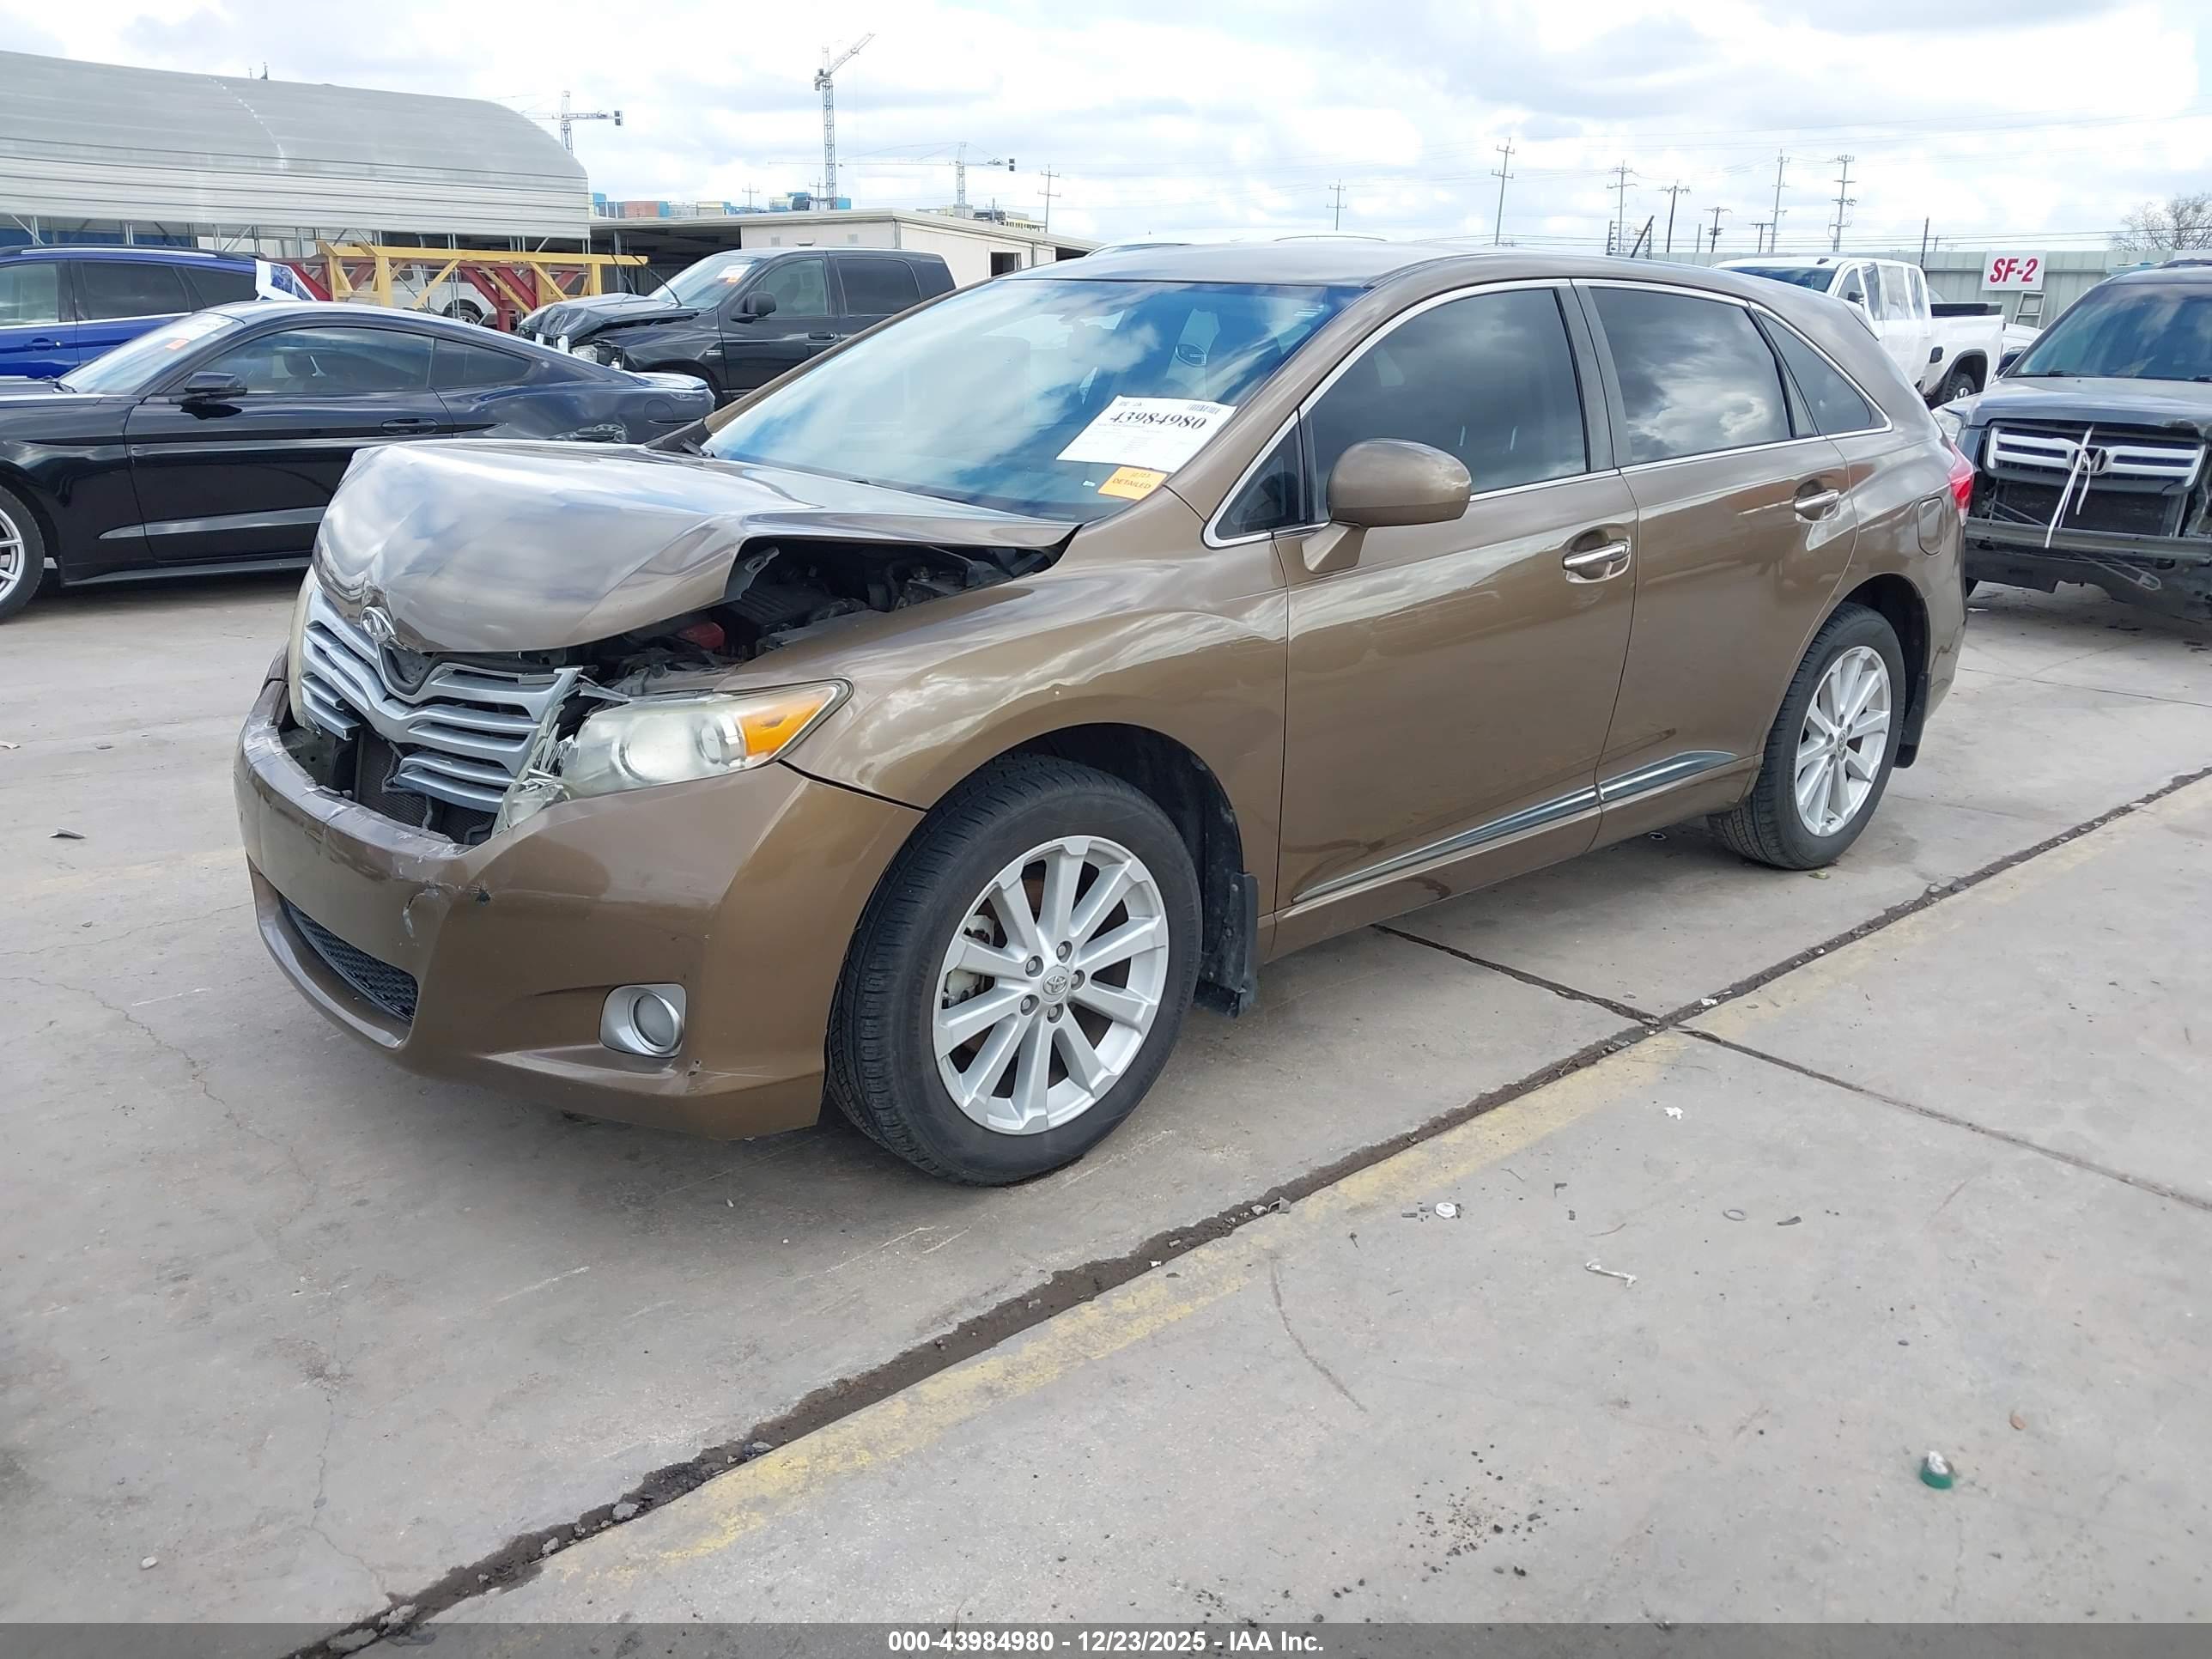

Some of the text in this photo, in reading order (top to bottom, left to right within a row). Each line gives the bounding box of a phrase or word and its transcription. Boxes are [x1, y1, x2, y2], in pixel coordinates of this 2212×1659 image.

[1990, 258, 2038, 283] SF-2
[1109, 411, 1207, 430] 43984980
[1112, 477, 1152, 489] DETAILED
